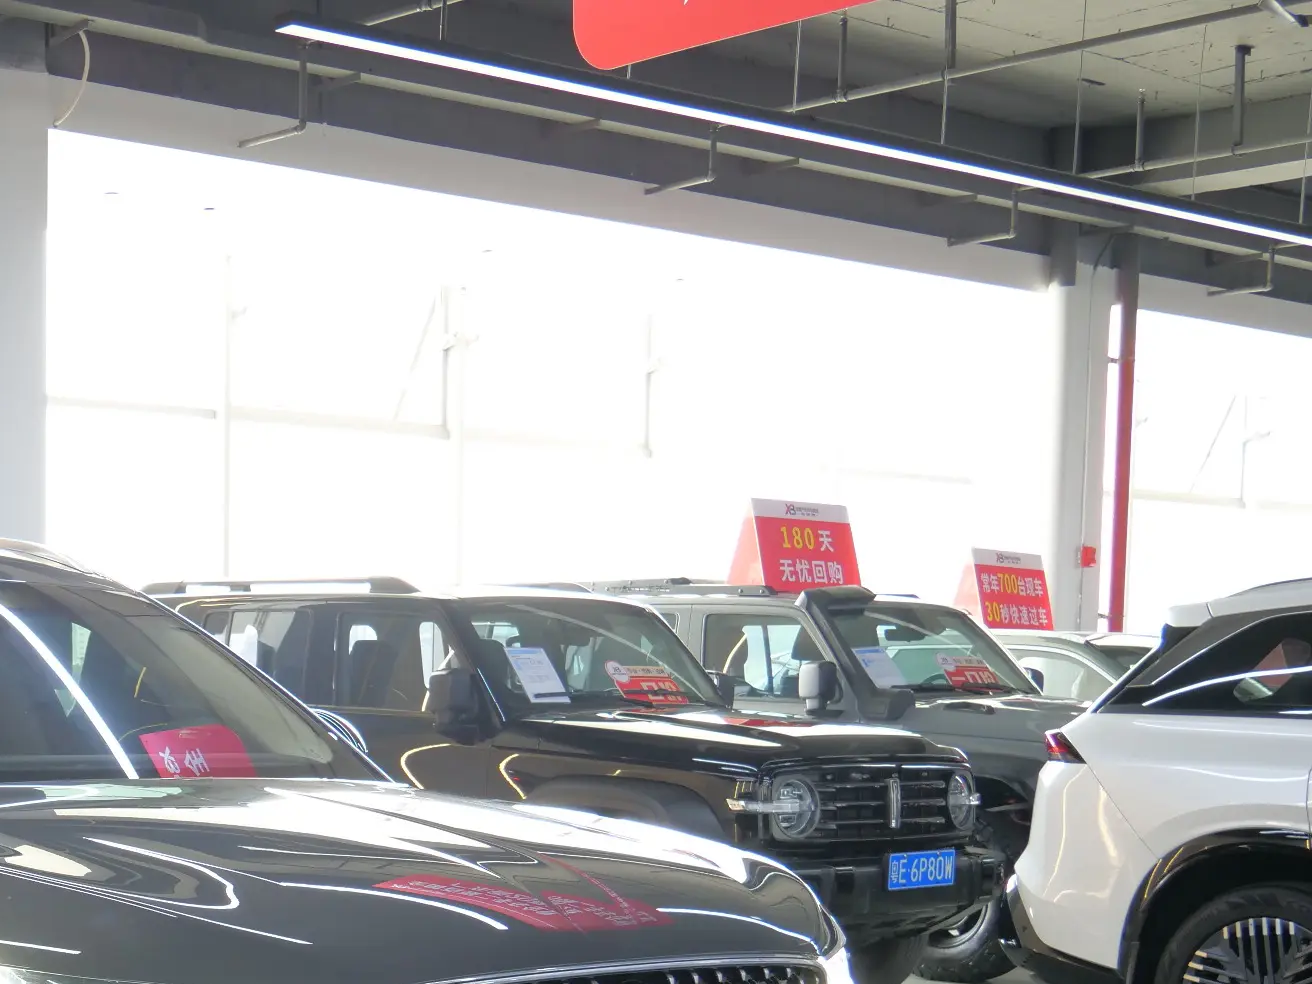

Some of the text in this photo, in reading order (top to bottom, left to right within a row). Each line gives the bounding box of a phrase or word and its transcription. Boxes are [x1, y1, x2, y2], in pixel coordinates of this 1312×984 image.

[780, 526, 834, 552] 180天
[779, 559, 844, 585] 无忧回购
[981, 572, 1044, 597] 常年700台现车
[985, 601, 1048, 626] 30秒快速过车
